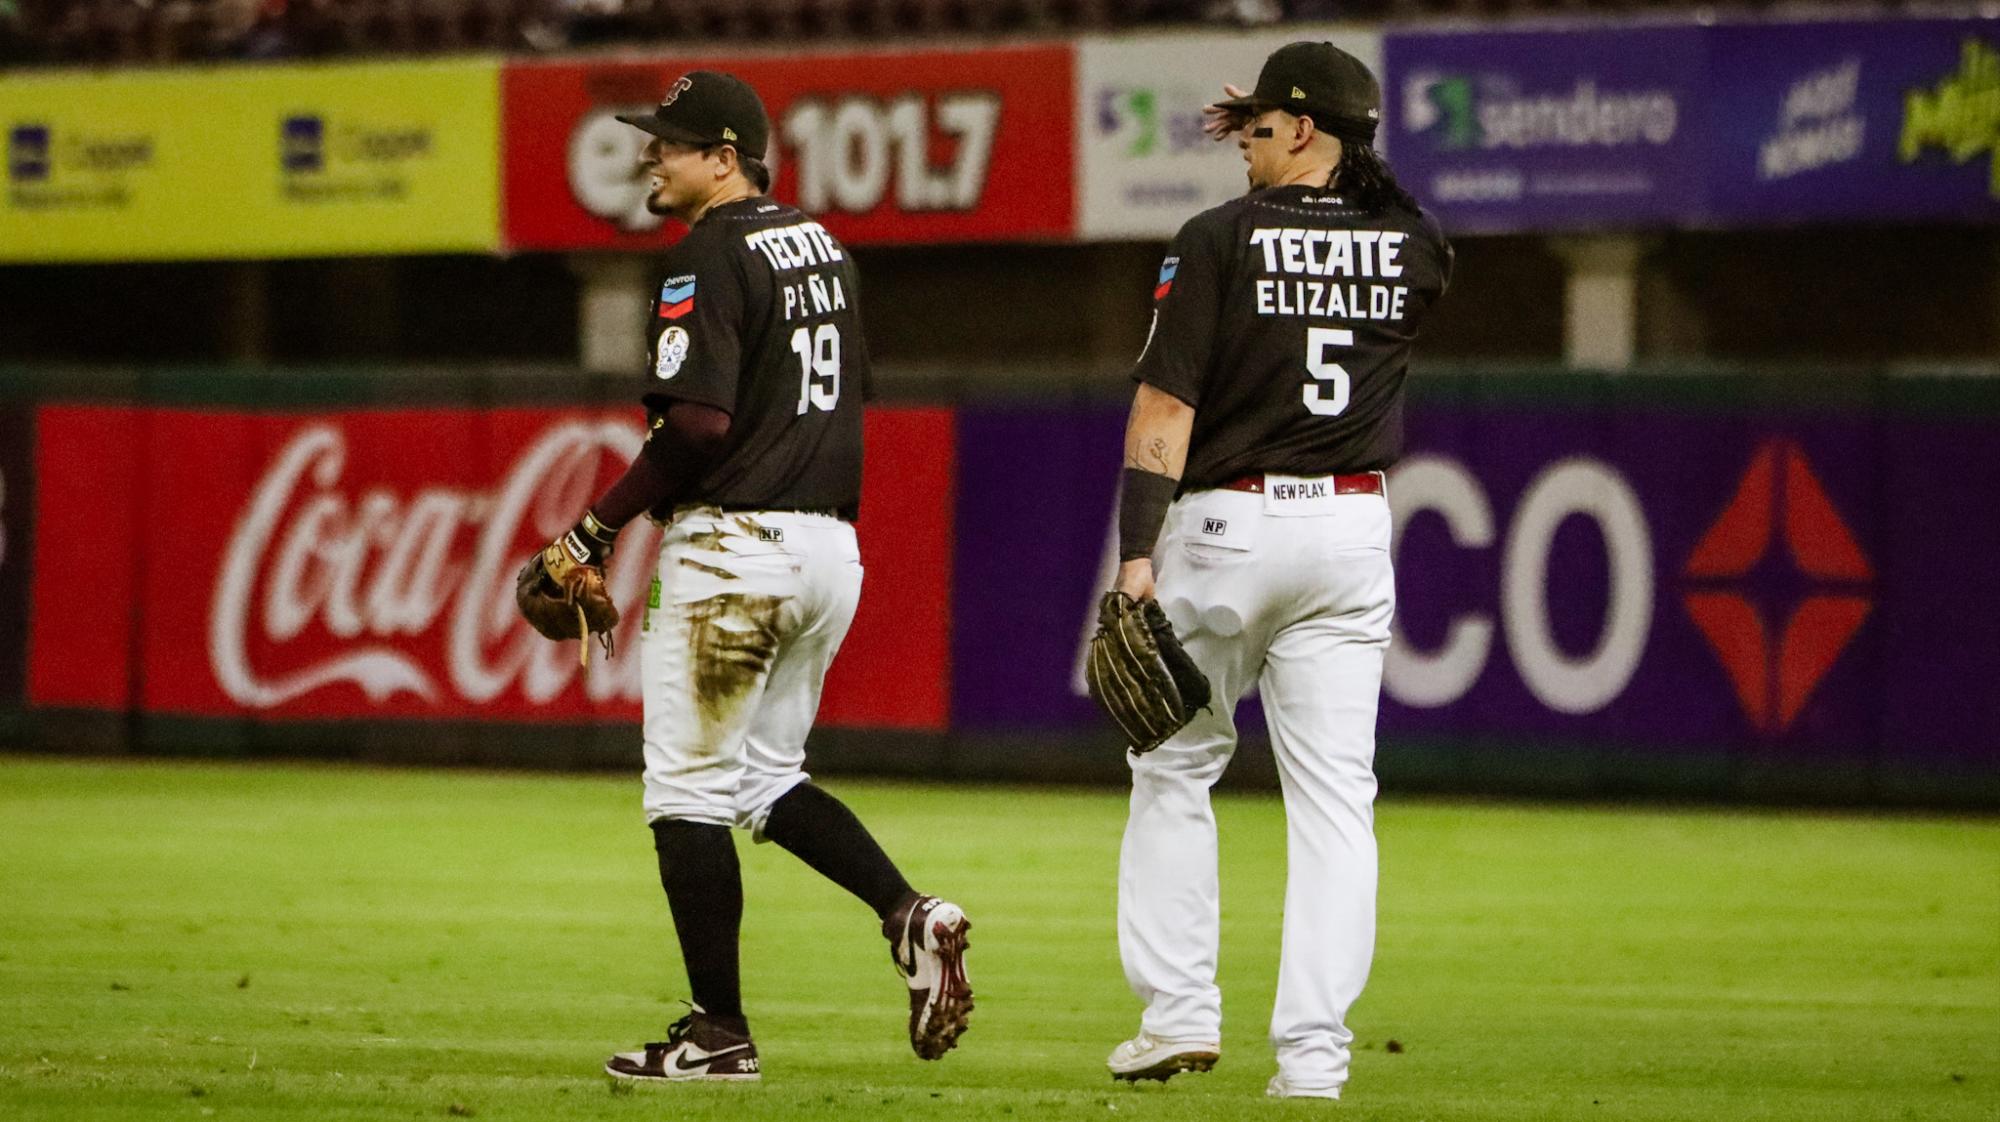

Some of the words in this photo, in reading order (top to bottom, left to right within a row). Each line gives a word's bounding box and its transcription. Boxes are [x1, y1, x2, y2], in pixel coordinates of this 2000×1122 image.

[745, 222, 843, 270] TECATE
[1250, 228, 1405, 278] TECATE
[784, 274, 846, 320] PEÑA
[1256, 280, 1408, 320] ELIZALDE
[791, 323, 840, 415] 19
[1303, 327, 1354, 416] 5
[1273, 484, 1297, 500] NEW
[761, 528, 781, 540] NP
[1204, 519, 1224, 534] NP
